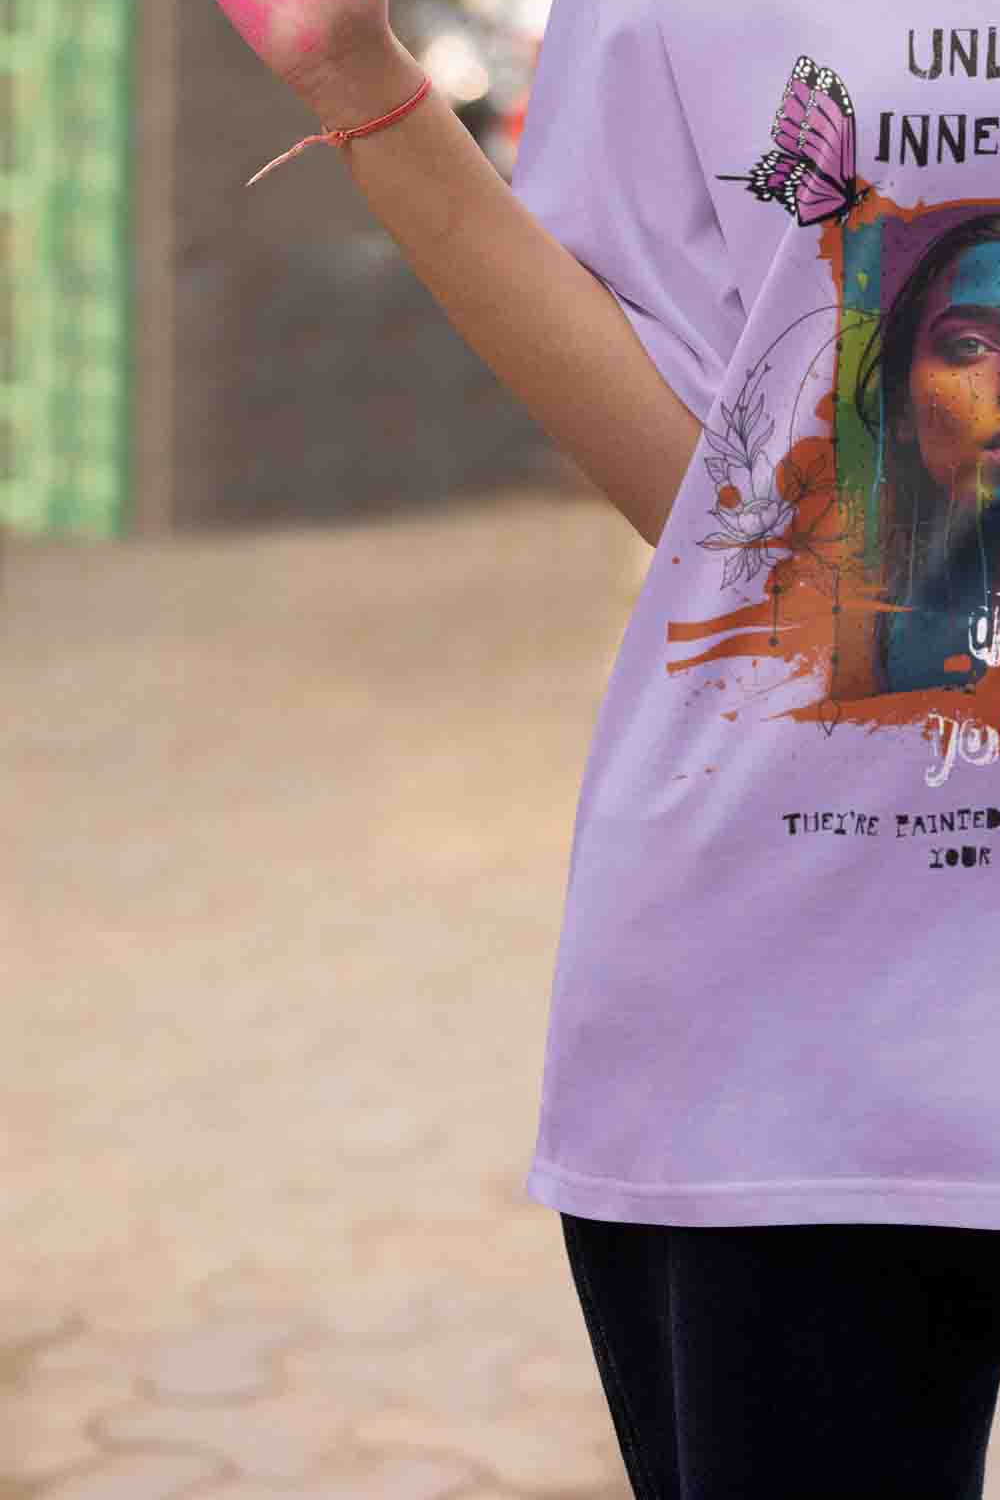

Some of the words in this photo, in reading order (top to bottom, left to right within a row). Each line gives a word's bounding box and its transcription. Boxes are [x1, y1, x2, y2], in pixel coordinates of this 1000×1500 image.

[782, 810, 880, 838] THEY'RE
[896, 808, 1000, 839] PAINTED
[929, 844, 992, 869] YOUR
